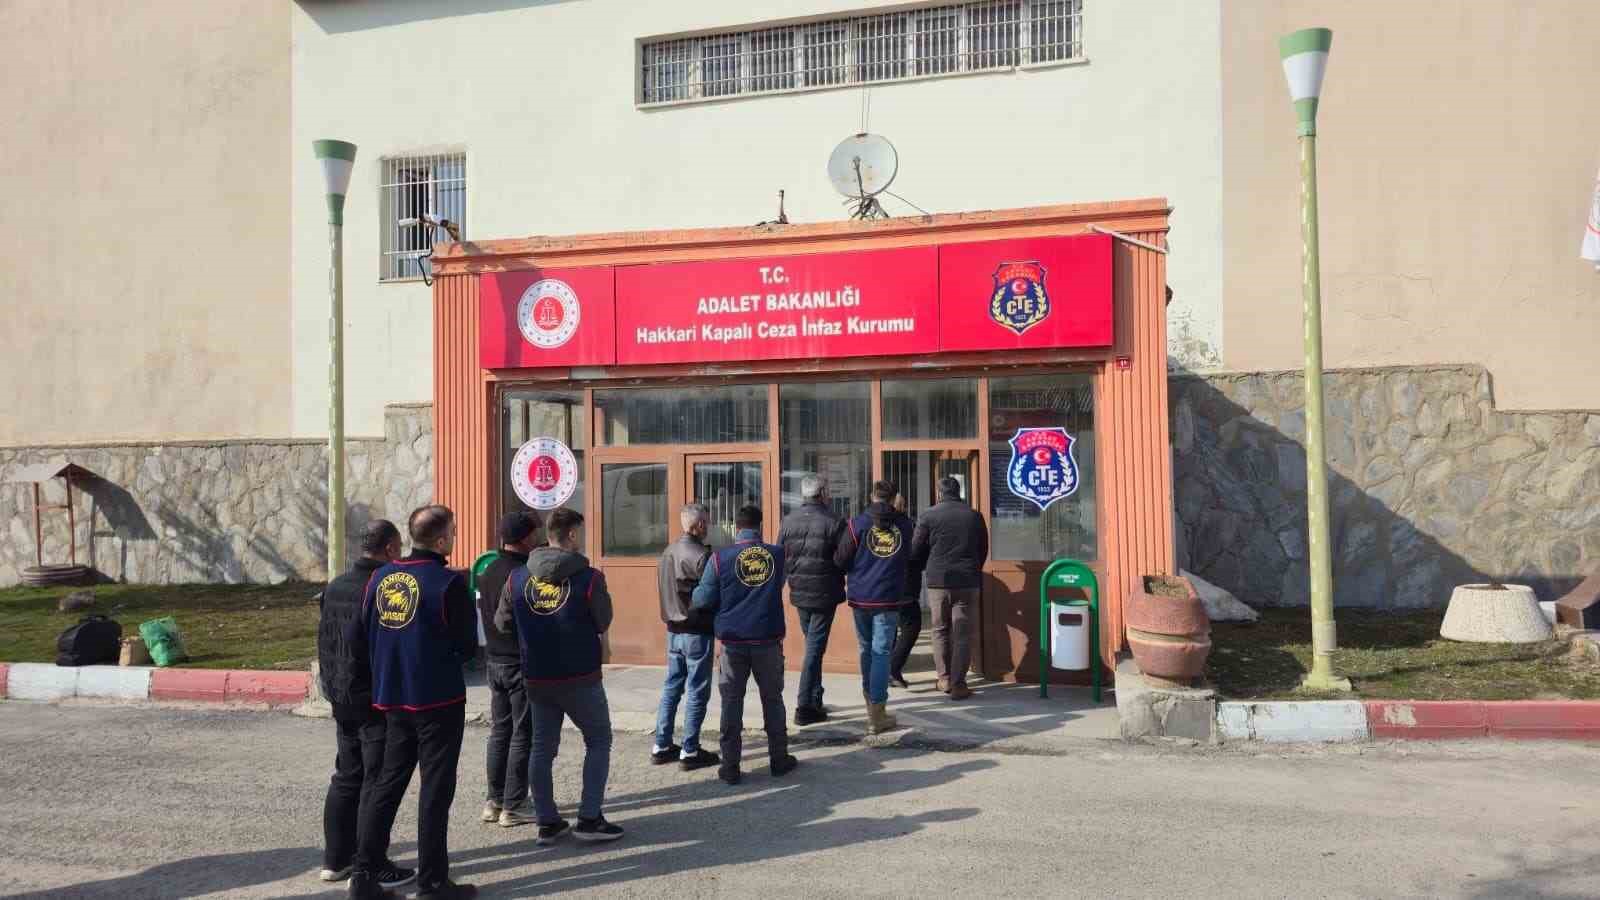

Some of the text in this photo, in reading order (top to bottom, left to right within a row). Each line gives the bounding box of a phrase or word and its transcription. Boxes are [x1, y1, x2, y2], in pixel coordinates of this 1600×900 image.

[759, 266, 789, 284] T.C.
[697, 286, 860, 314] ADALET BAKANLIĞI
[1007, 295, 1033, 315] CTE
[636, 315, 915, 343] Hakkari Kapalı Ceza İnfaz Kurumu
[1028, 465, 1058, 486] CTE
